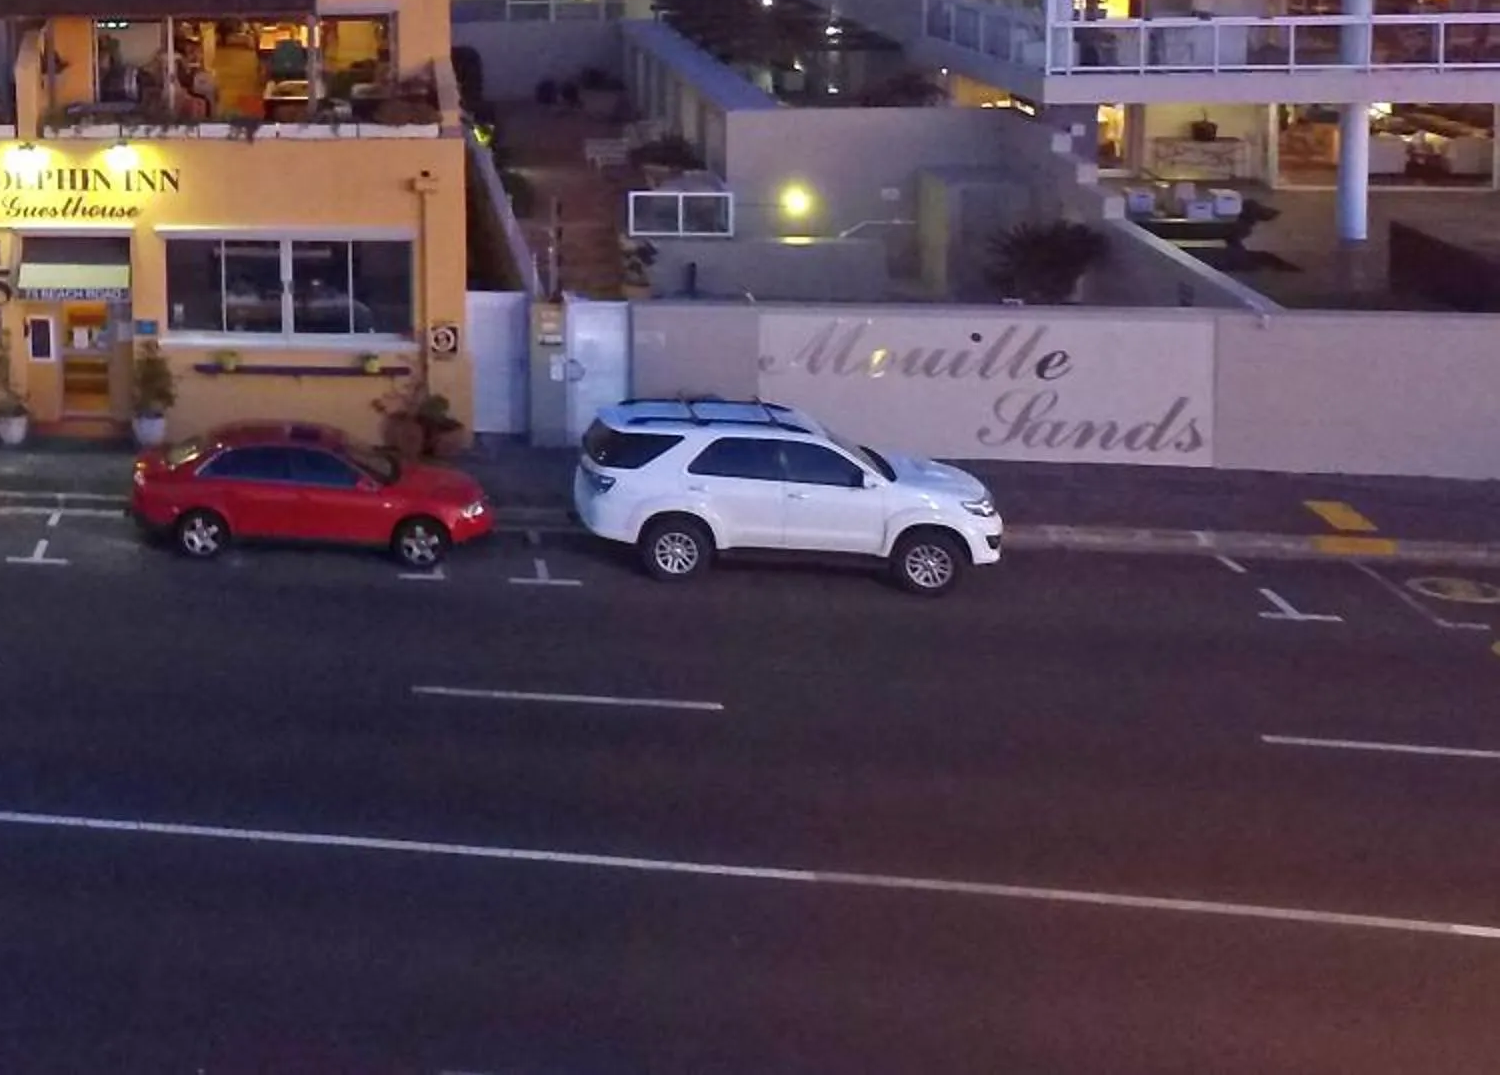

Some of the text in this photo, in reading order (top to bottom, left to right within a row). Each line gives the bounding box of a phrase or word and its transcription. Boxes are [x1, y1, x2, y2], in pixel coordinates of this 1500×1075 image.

[124, 168, 181, 192] INN
[1, 195, 142, 219] Guesthouse
[758, 317, 1073, 381] Mouille
[976, 388, 1204, 454] Sands
